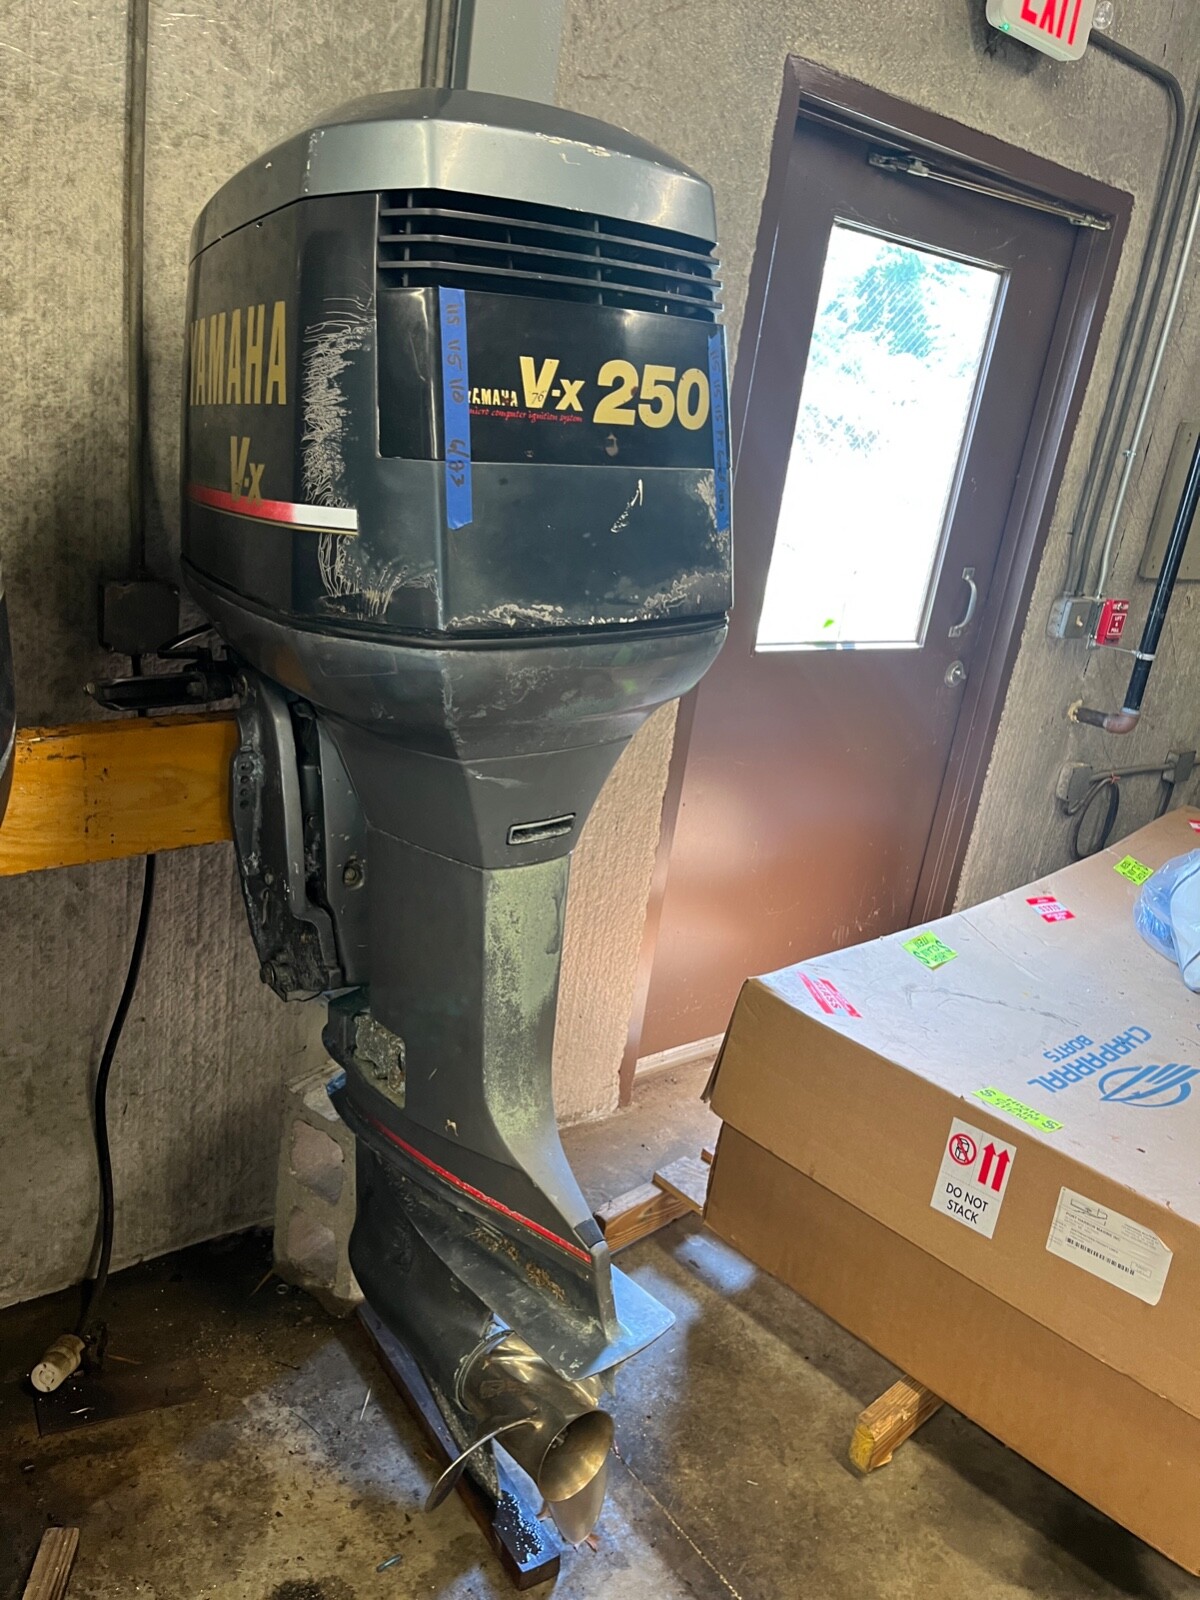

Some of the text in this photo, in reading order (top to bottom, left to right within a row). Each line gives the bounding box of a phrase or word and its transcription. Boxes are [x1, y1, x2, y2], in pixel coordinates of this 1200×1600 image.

[189, 300, 287, 406] YAMAHA
[468, 387, 519, 408] AMAHA
[593, 359, 710, 430] 250
[491, 409, 527, 421] computer
[528, 410, 558, 423] ignition
[559, 413, 583, 424] system
[1027, 1025, 1152, 1093] CHAPARRAL
[1043, 1034, 1094, 1063] BOATS
[946, 1182, 989, 1212] DO NOT
[946, 1199, 979, 1224] STACK
